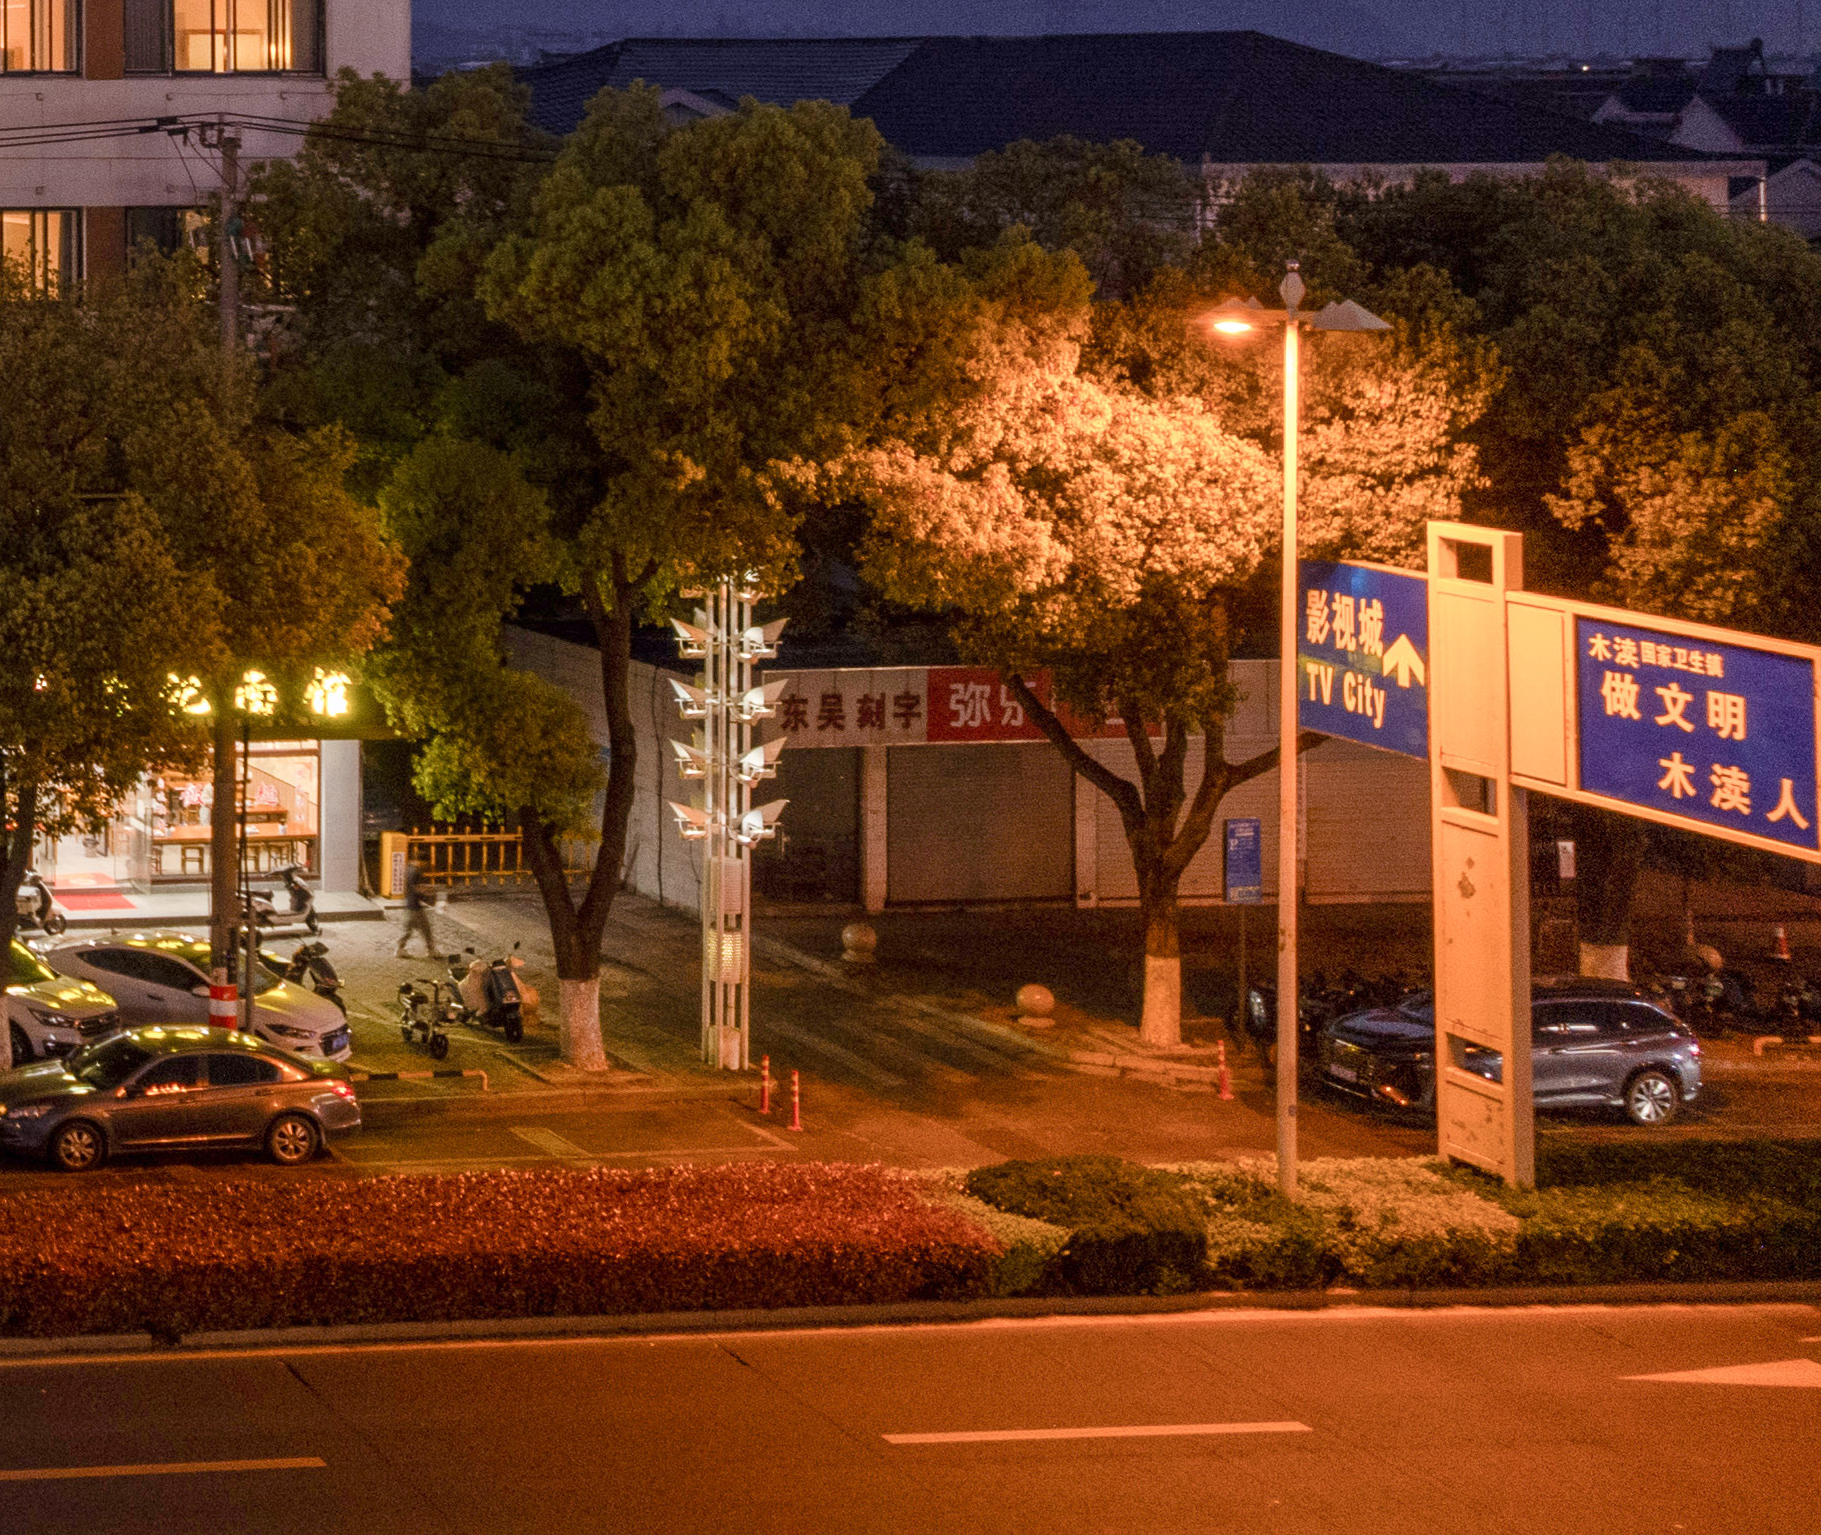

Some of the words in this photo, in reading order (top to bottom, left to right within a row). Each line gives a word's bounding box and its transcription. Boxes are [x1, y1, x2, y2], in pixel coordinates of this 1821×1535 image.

[1306, 589, 1384, 657] 影视城
[780, 690, 922, 732] 东吴刻字
[1306, 662, 1334, 705] TV
[1343, 671, 1385, 729] City
[1601, 670, 1747, 741] 做文明
[1658, 752, 1810, 831] 木渎人
